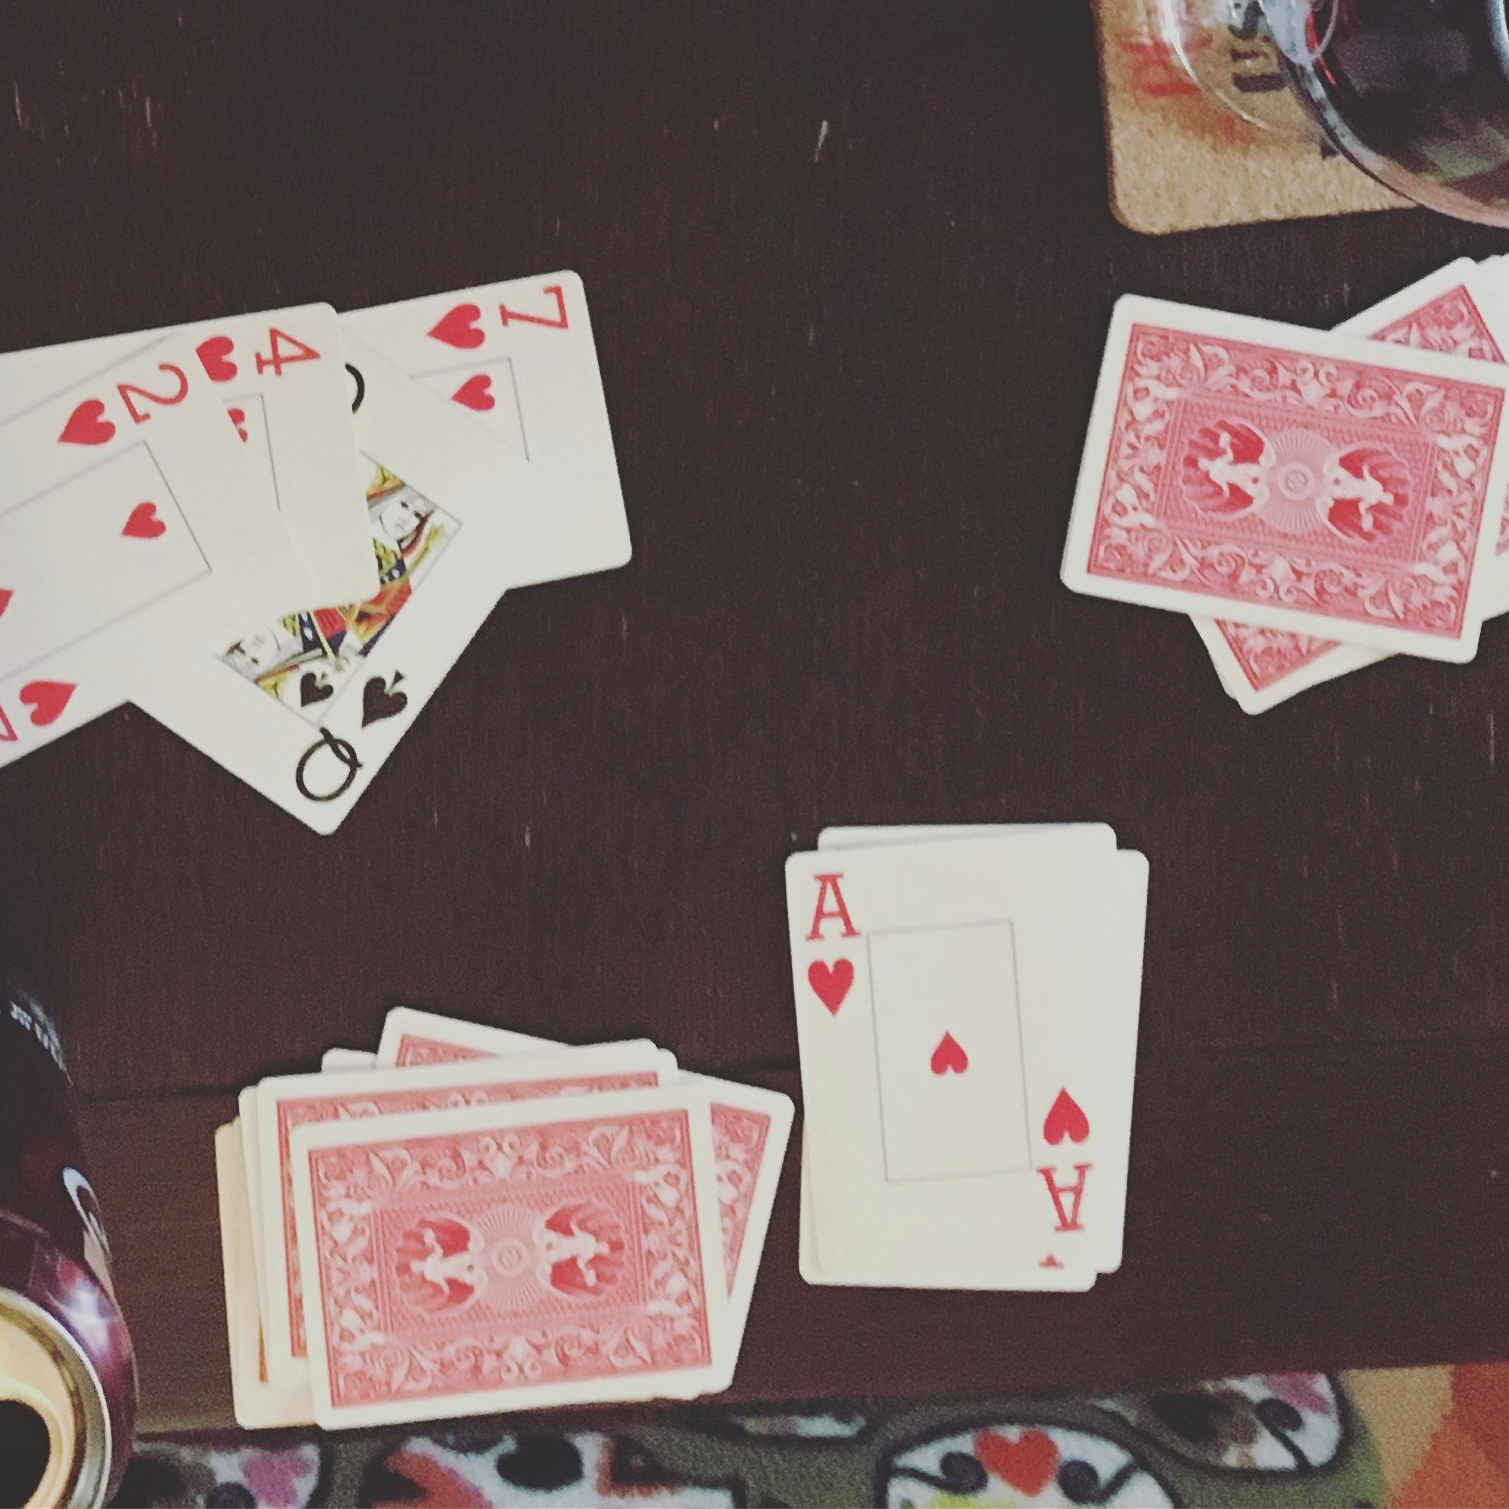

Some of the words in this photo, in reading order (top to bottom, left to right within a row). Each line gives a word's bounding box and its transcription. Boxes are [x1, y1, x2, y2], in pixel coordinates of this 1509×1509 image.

[499, 285, 569, 331] 7
[255, 328, 321, 377] 4
[116, 363, 190, 425] 2
[295, 727, 363, 803] Q
[806, 873, 860, 941] A
[1038, 1163, 1092, 1233] A
